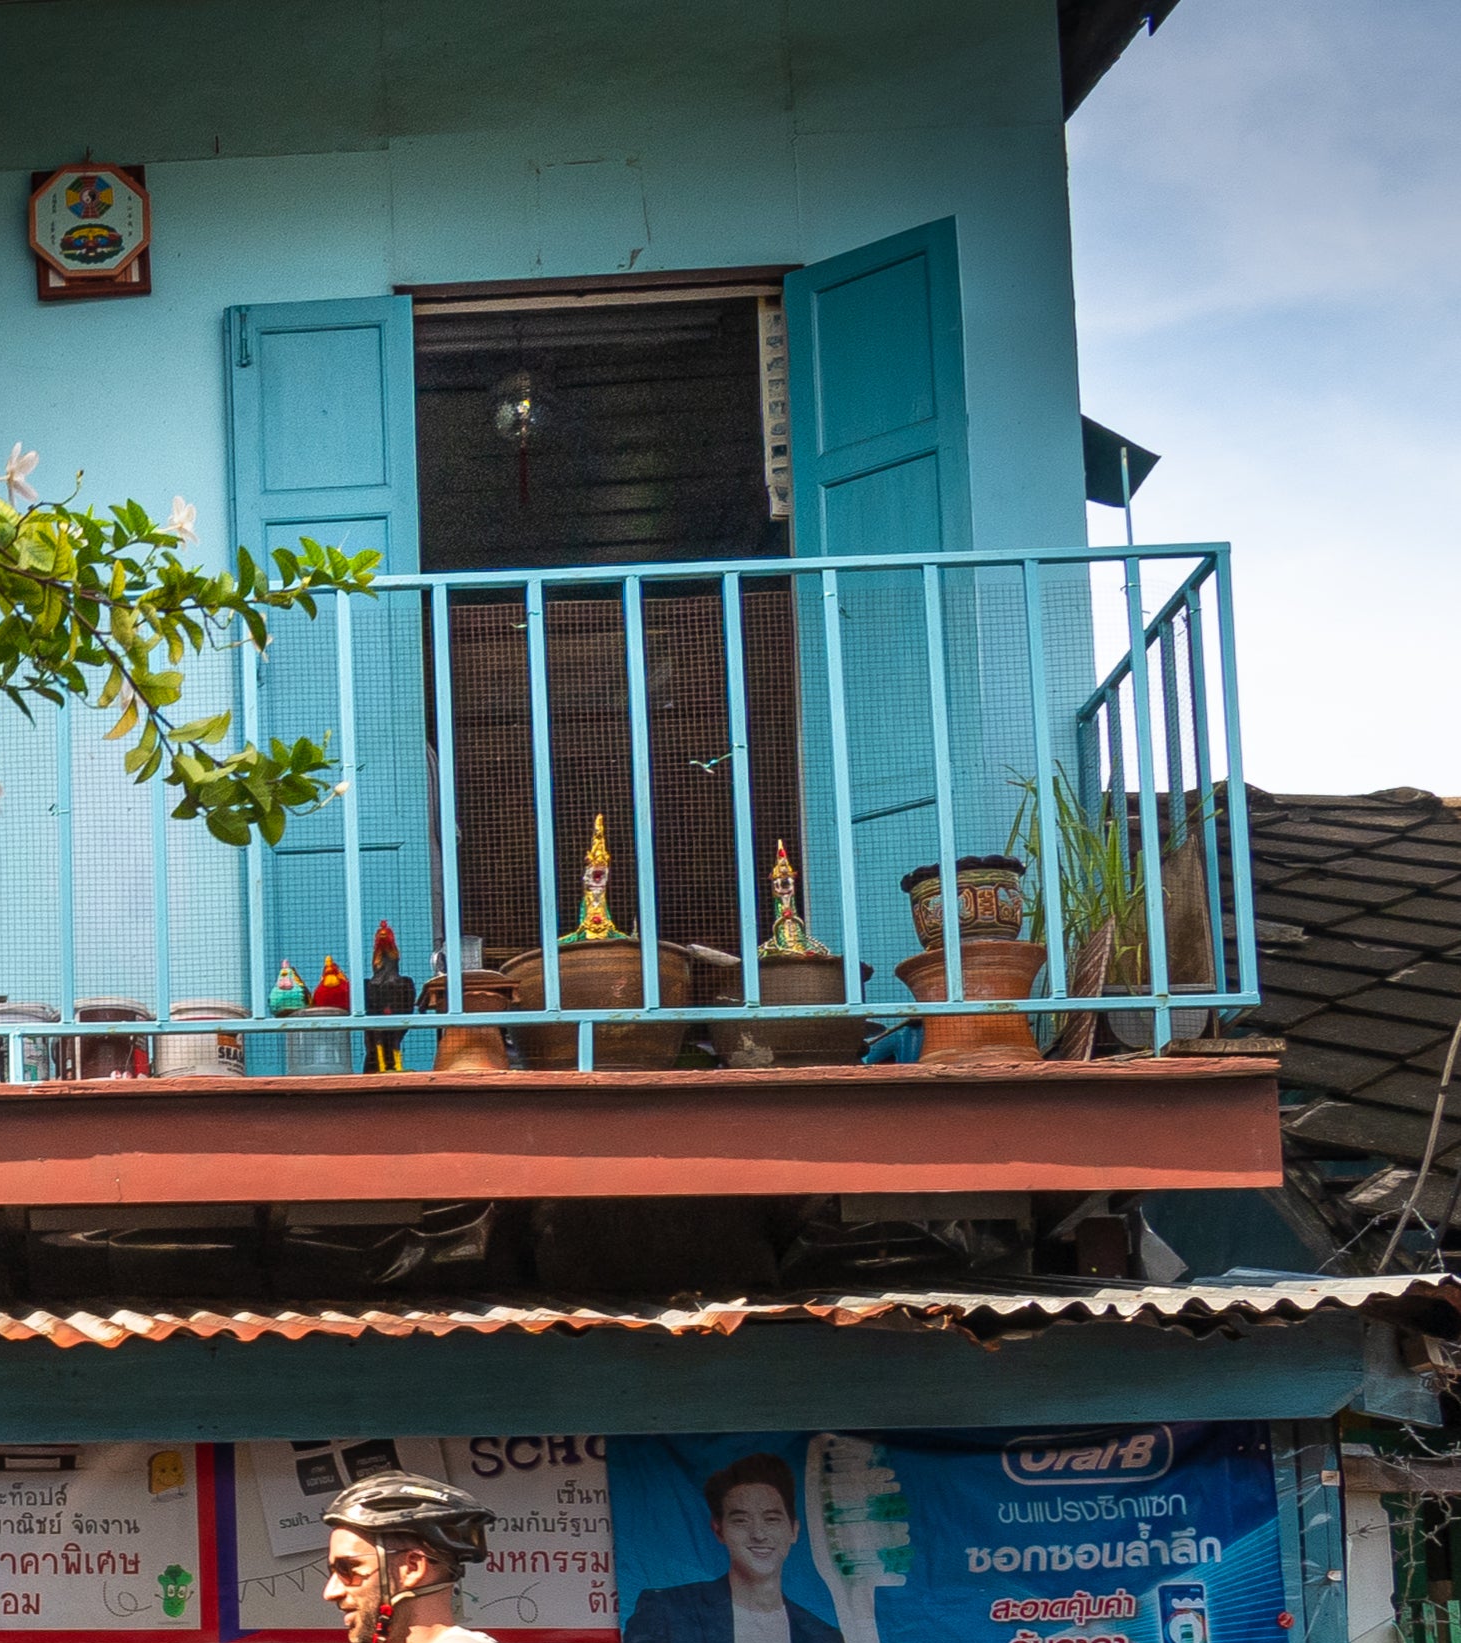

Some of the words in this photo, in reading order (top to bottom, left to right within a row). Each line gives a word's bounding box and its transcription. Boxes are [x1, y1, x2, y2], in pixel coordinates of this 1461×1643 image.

[1019, 1434, 1156, 1472] Oral-B
[71, 1513, 141, 1536] จัดงาน
[998, 1494, 1188, 1524] ขนแปรงซิกแซก
[966, 1523, 1222, 1574] ซอกซอนล้ำลึก
[990, 1589, 1135, 1625] สะอาดคุ้มค่า
